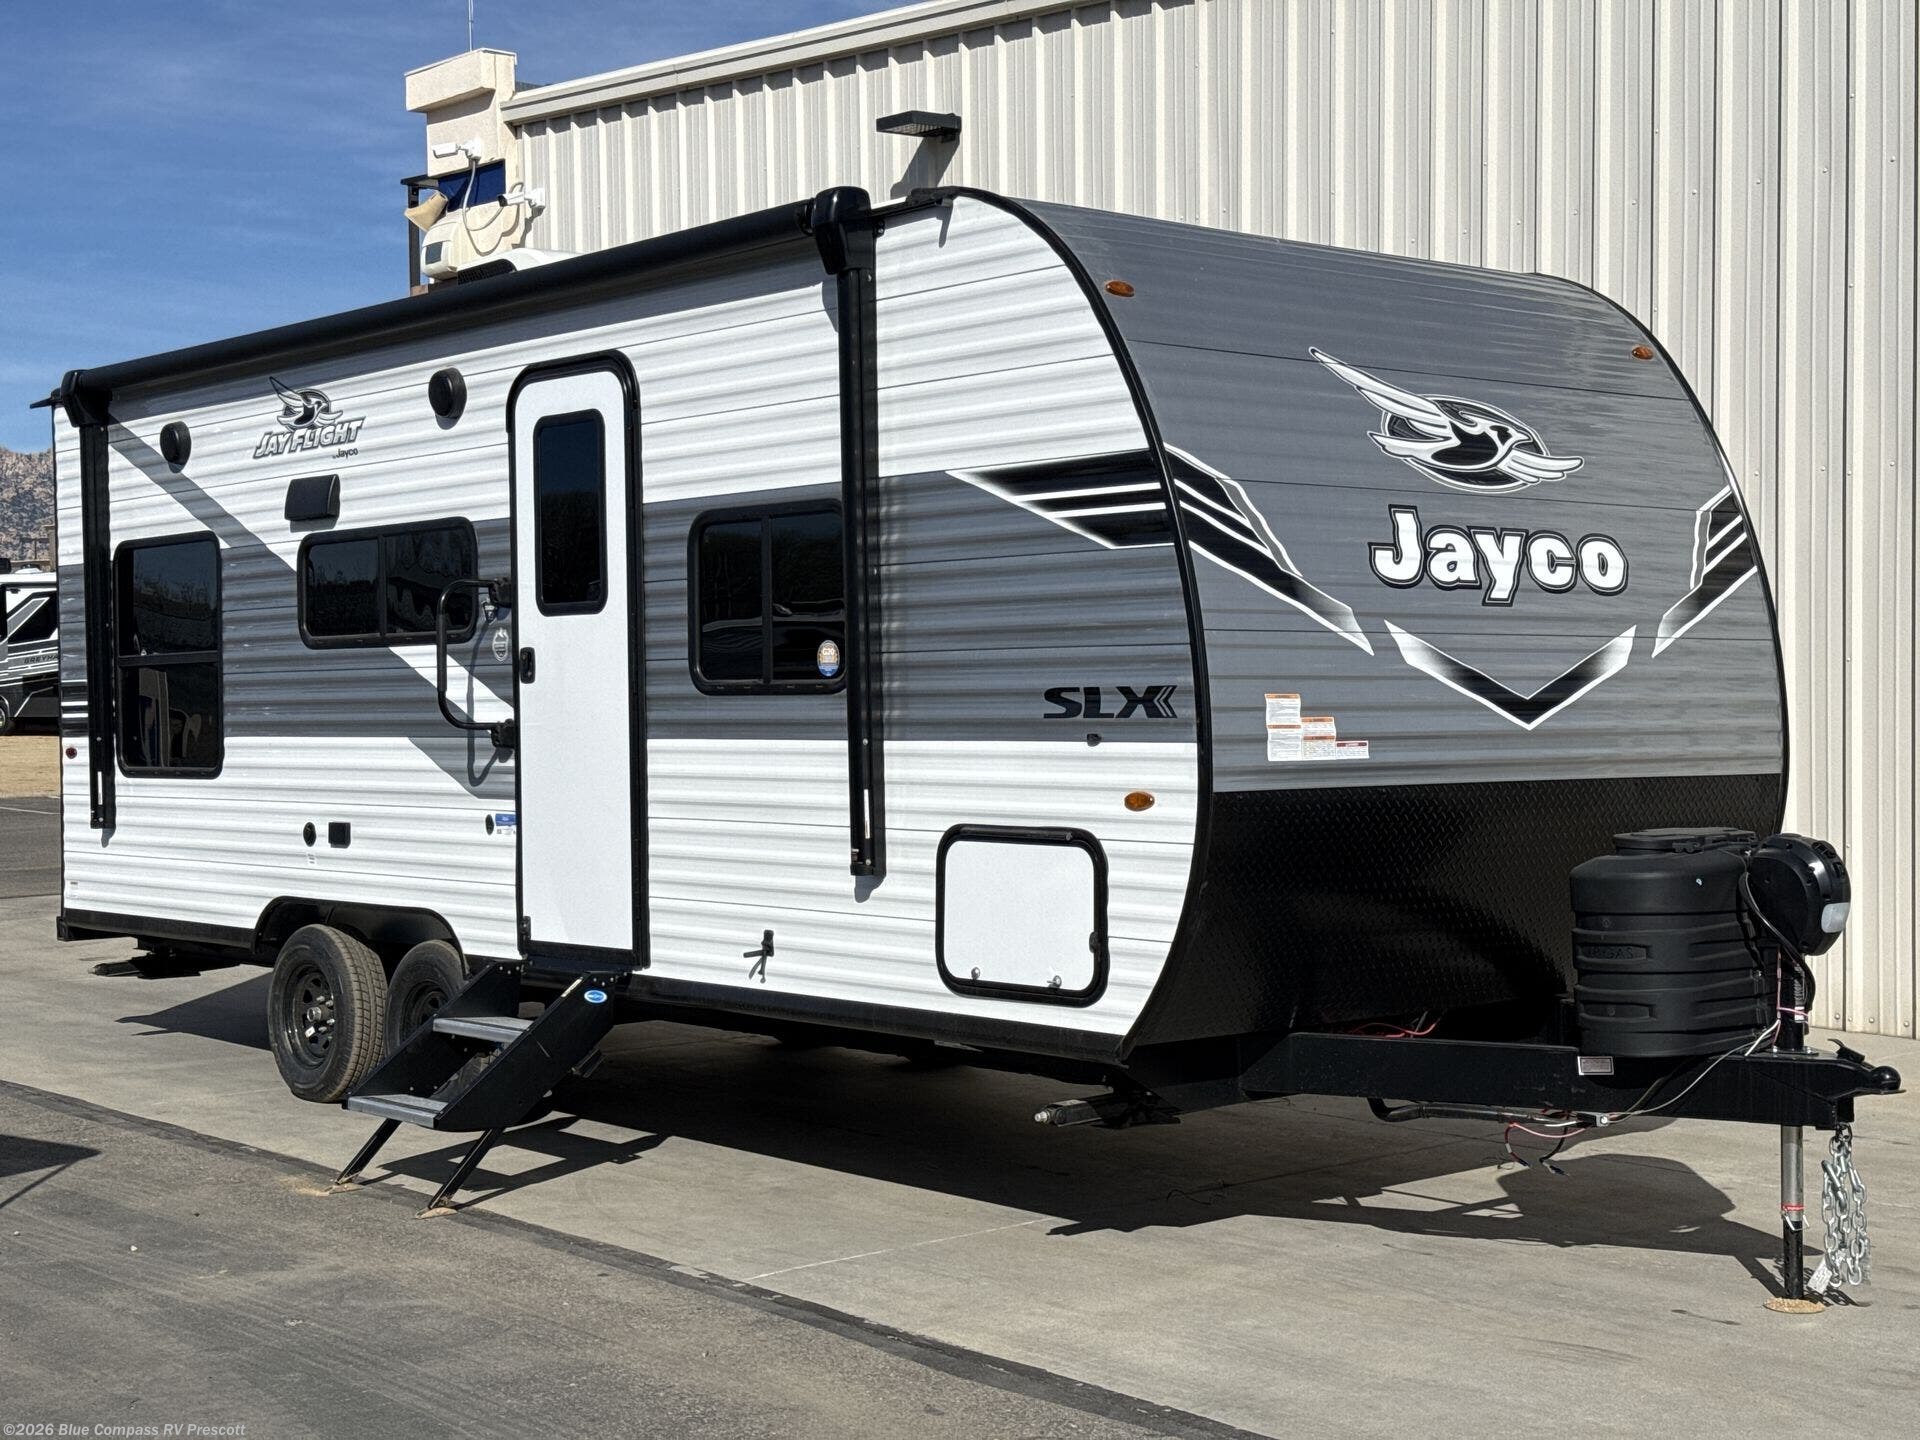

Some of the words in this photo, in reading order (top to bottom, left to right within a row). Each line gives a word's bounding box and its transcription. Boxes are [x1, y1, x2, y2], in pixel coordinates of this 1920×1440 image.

[336, 448, 359, 459] Jayco
[1367, 503, 1629, 607] Jayco
[1043, 685, 1178, 719] SLX
